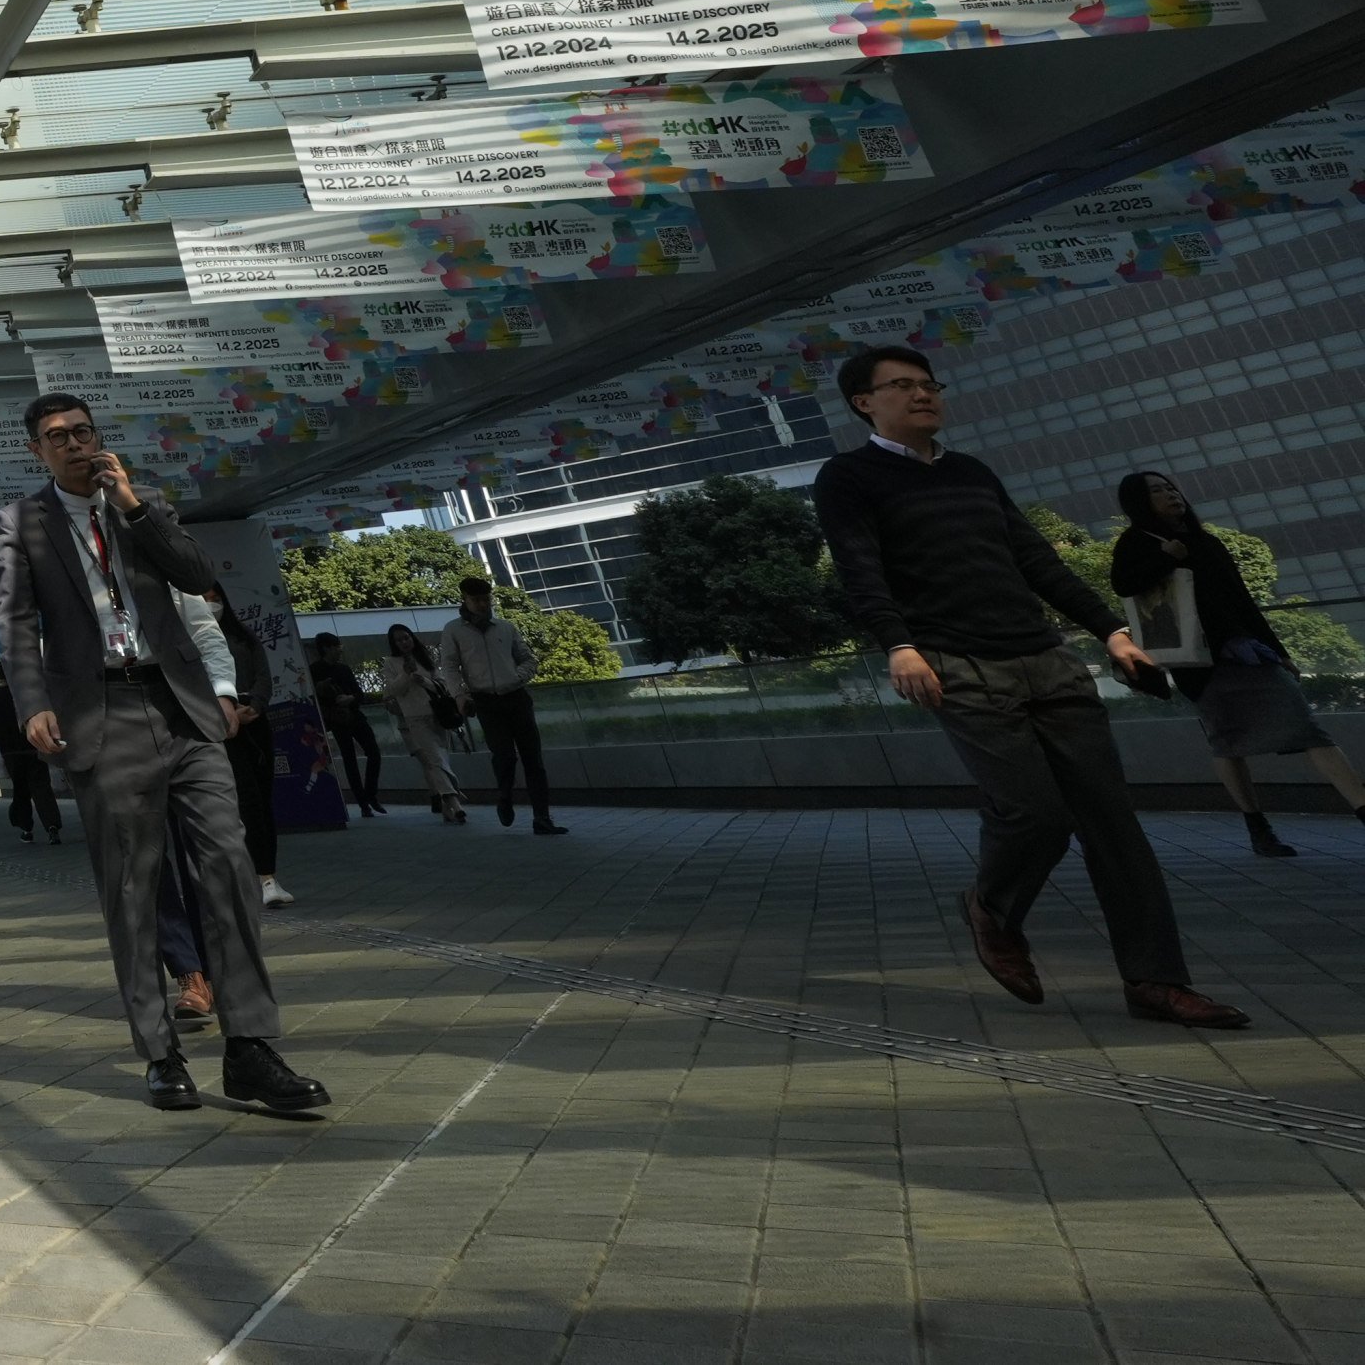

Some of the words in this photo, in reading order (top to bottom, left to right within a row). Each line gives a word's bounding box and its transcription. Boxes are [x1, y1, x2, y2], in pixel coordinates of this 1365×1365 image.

[491, 23, 555, 37] CREATIVE
[558, 19, 613, 31] JOURNEY
[628, 11, 689, 26] INFINITE
[693, 3, 770, 20] DISCOVERY
[496, 37, 613, 61] 12.12.2024
[666, 21, 779, 46] 14.2.2025
[504, 58, 615, 76] www.designdistrict.hk
[732, 137, 781, 152] 沙頭角
[315, 161, 365, 172] CREATIVE
[367, 159, 413, 169] JOURNEY
[426, 154, 474, 166] INFINITE
[477, 150, 540, 161] DISCOVERY
[319, 175, 410, 190] 12.12.2024
[456, 165, 546, 183] 14.2.2025
[1074, 197, 1153, 216] 14.2.2025
[195, 260, 238, 268] CREATIVE
[240, 257, 278, 266] JOURNEY
[288, 254, 329, 264] INFINITE
[332, 251, 383, 261] DISCOVERY
[199, 271, 277, 285] 12.12.2024
[315, 264, 388, 279] 14.2.2025
[868, 281, 935, 299] 14.2.2025
[231, 326, 276, 336] DISCOVERY
[118, 344, 184, 357] 12.12.2024
[216, 339, 280, 352] 14.2.2025
[705, 342, 763, 357] 14.2.2025
[138, 389, 195, 401] 14.2.2025
[576, 391, 628, 404] 14.2.2025
[474, 429, 520, 442] 14.2.2025
[392, 459, 435, 471] 14.2.2025
